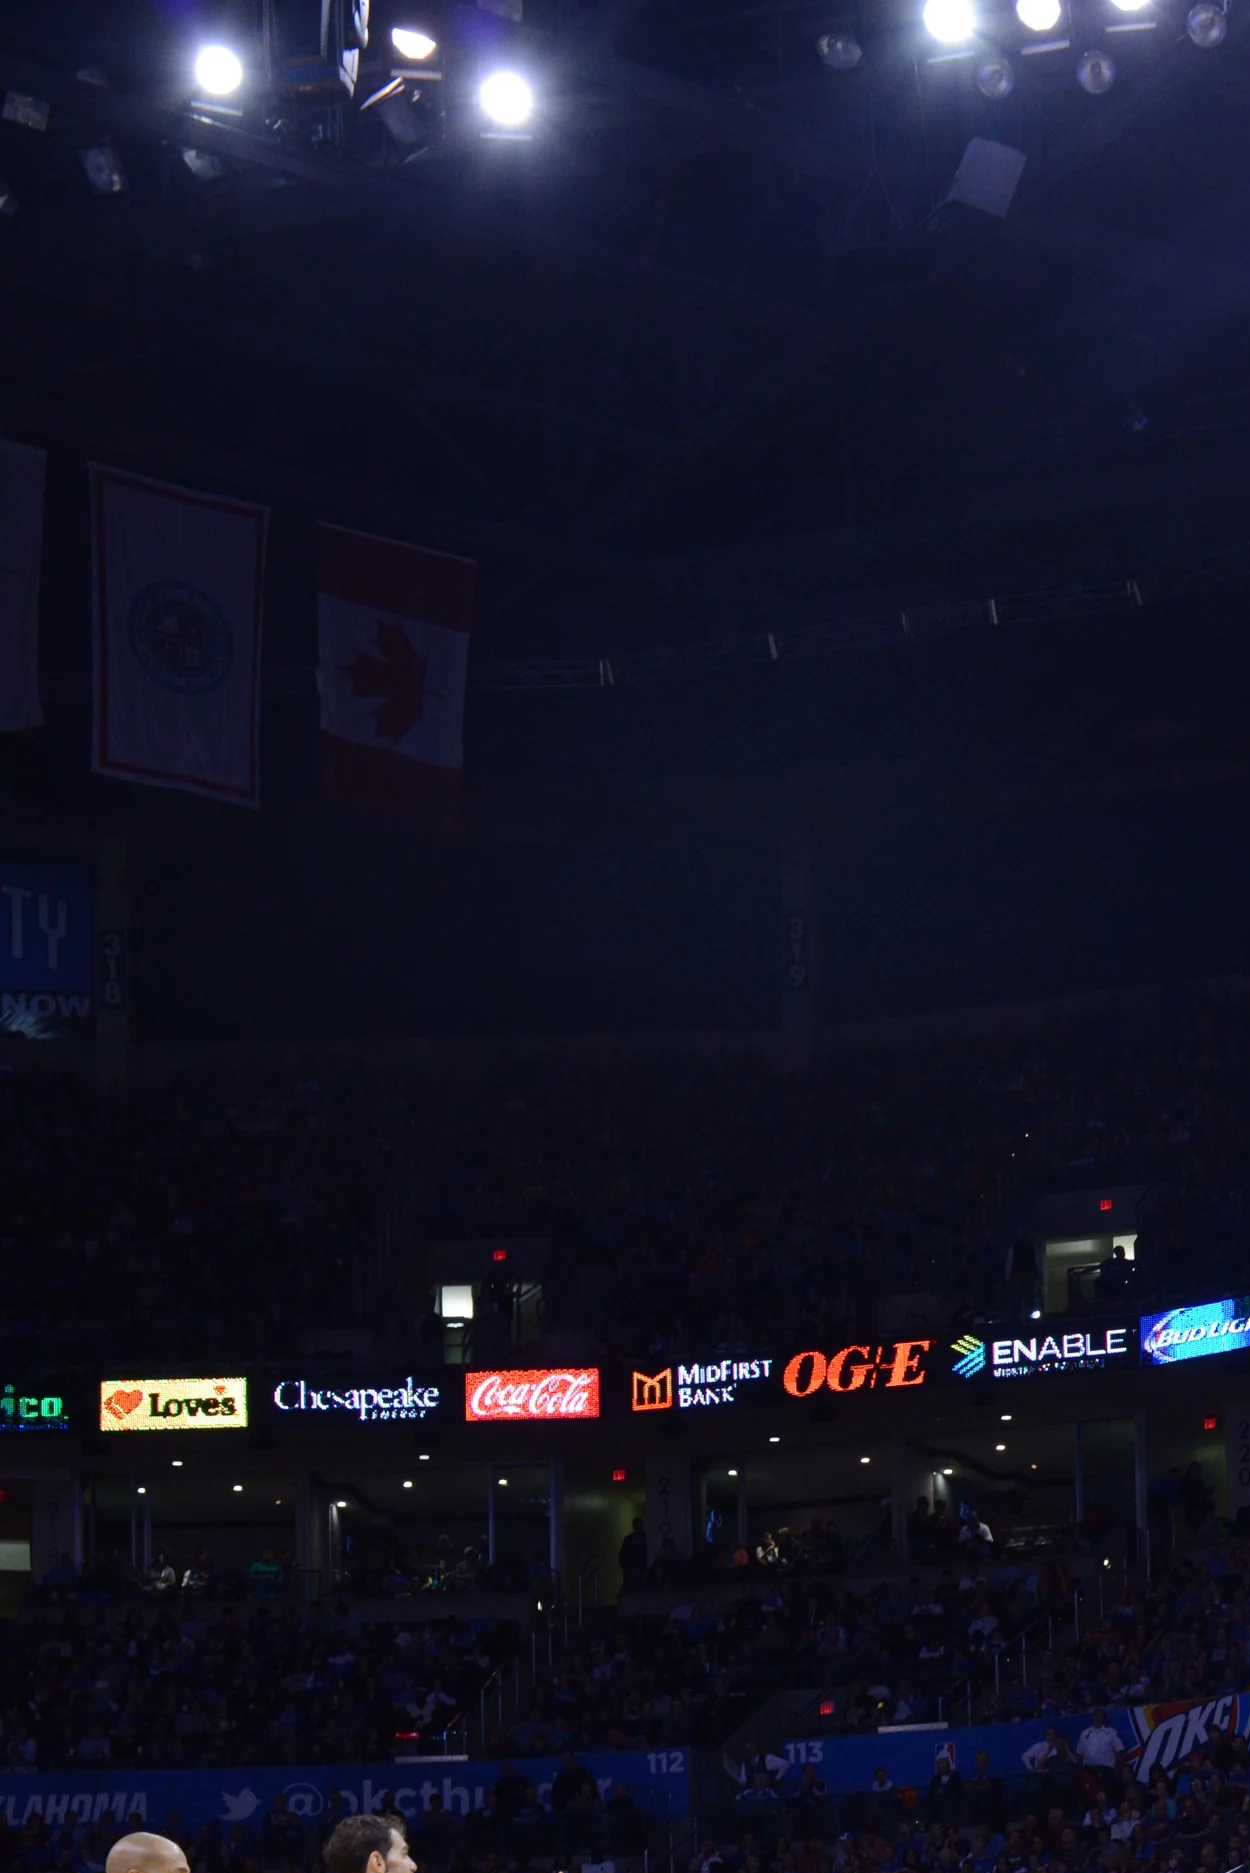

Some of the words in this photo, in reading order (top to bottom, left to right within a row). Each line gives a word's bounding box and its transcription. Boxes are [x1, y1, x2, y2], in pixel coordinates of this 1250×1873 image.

[103, 933, 122, 1004] 318
[787, 917, 806, 988] 319
[992, 1328, 1128, 1365] ENABLE
[273, 1376, 440, 1421] Chesapeake
[679, 1385, 735, 1409] BANK
[785, 1741, 824, 1765] 113
[1136, 1695, 1236, 1784] OKC
[646, 1752, 685, 1774] 112
[0, 1791, 148, 1826] LAHOMA
